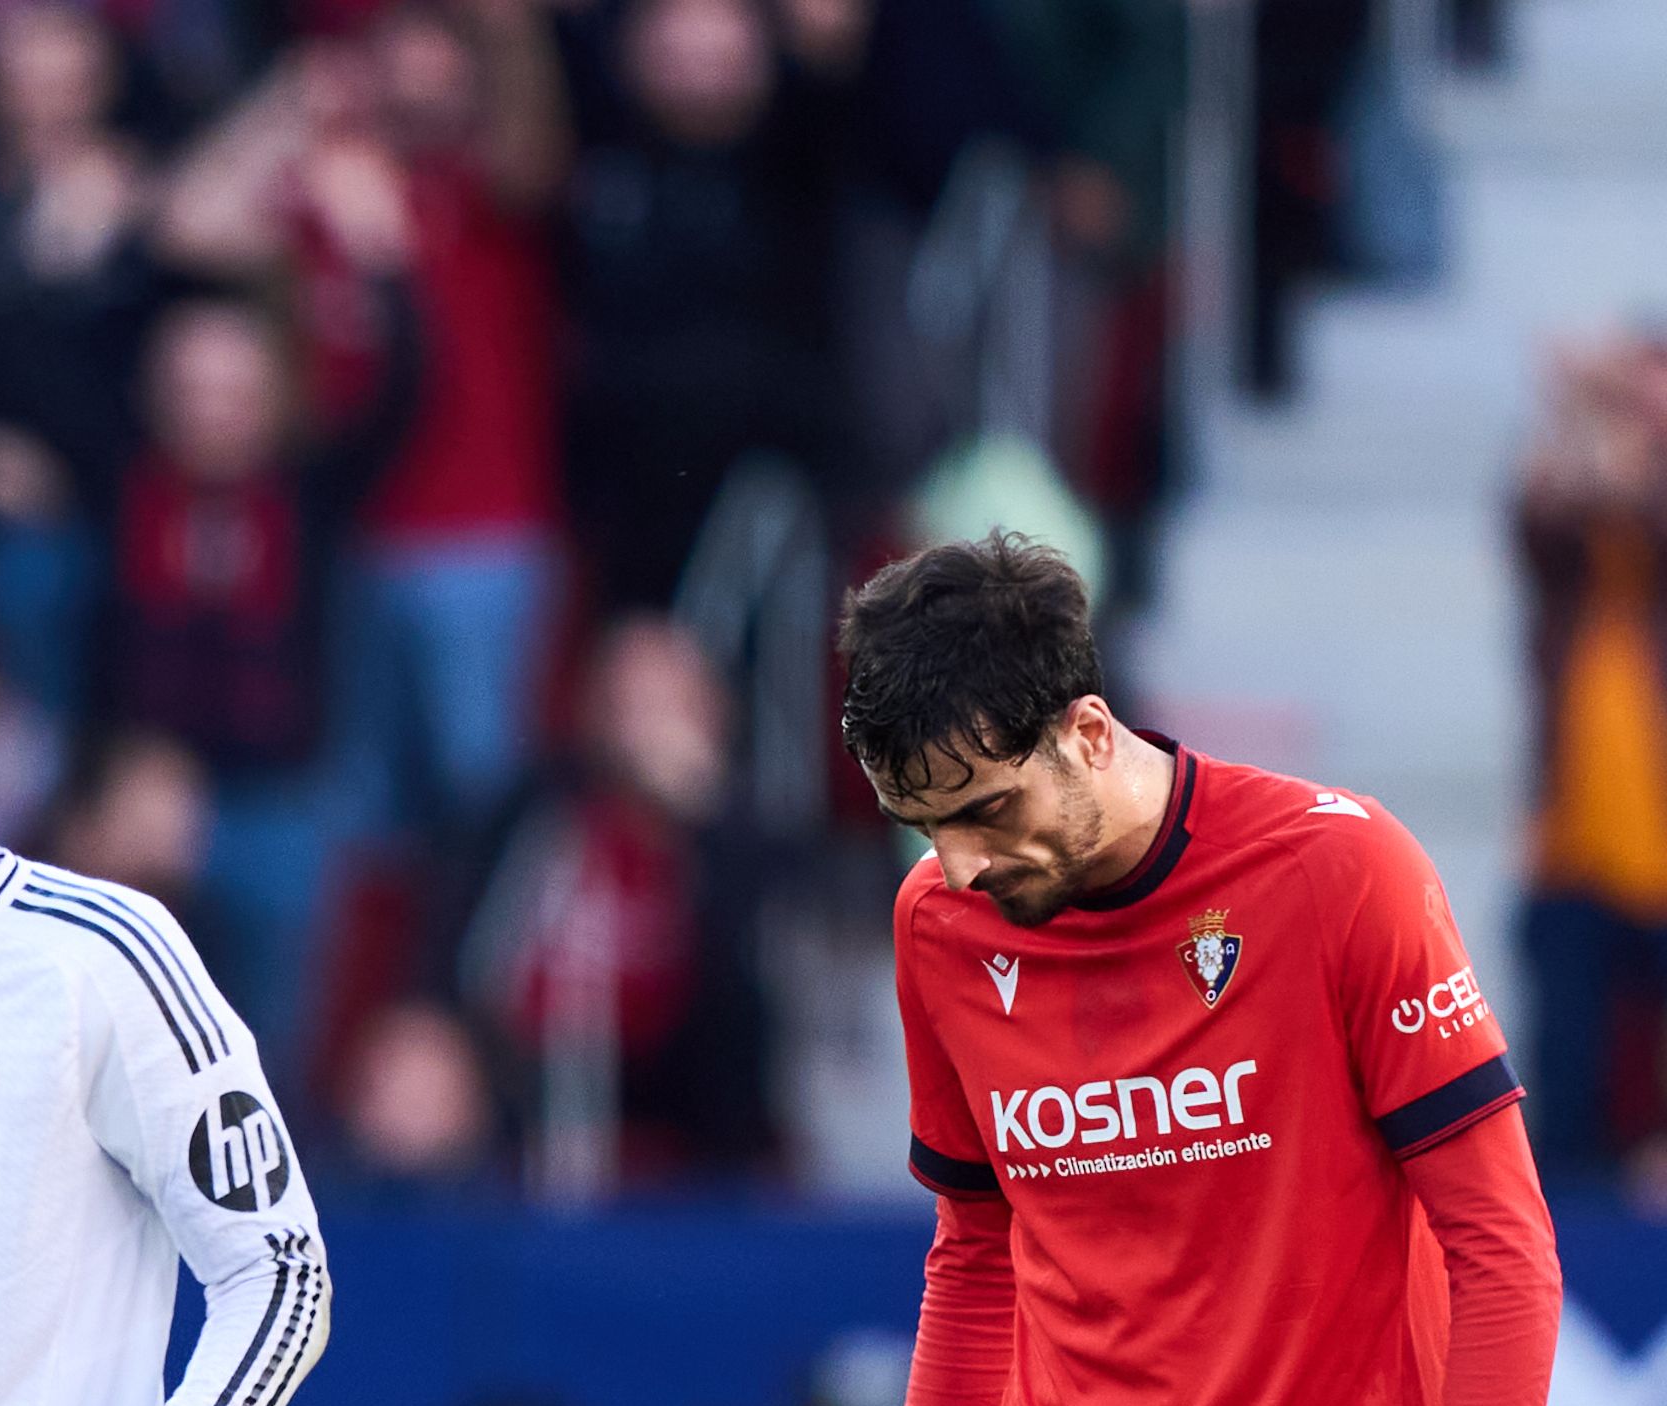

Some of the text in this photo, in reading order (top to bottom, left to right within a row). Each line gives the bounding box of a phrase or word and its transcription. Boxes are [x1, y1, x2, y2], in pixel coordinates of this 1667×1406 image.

[207, 1090, 281, 1212] hp
[1055, 1132, 1272, 1177] Climatización eficiente
